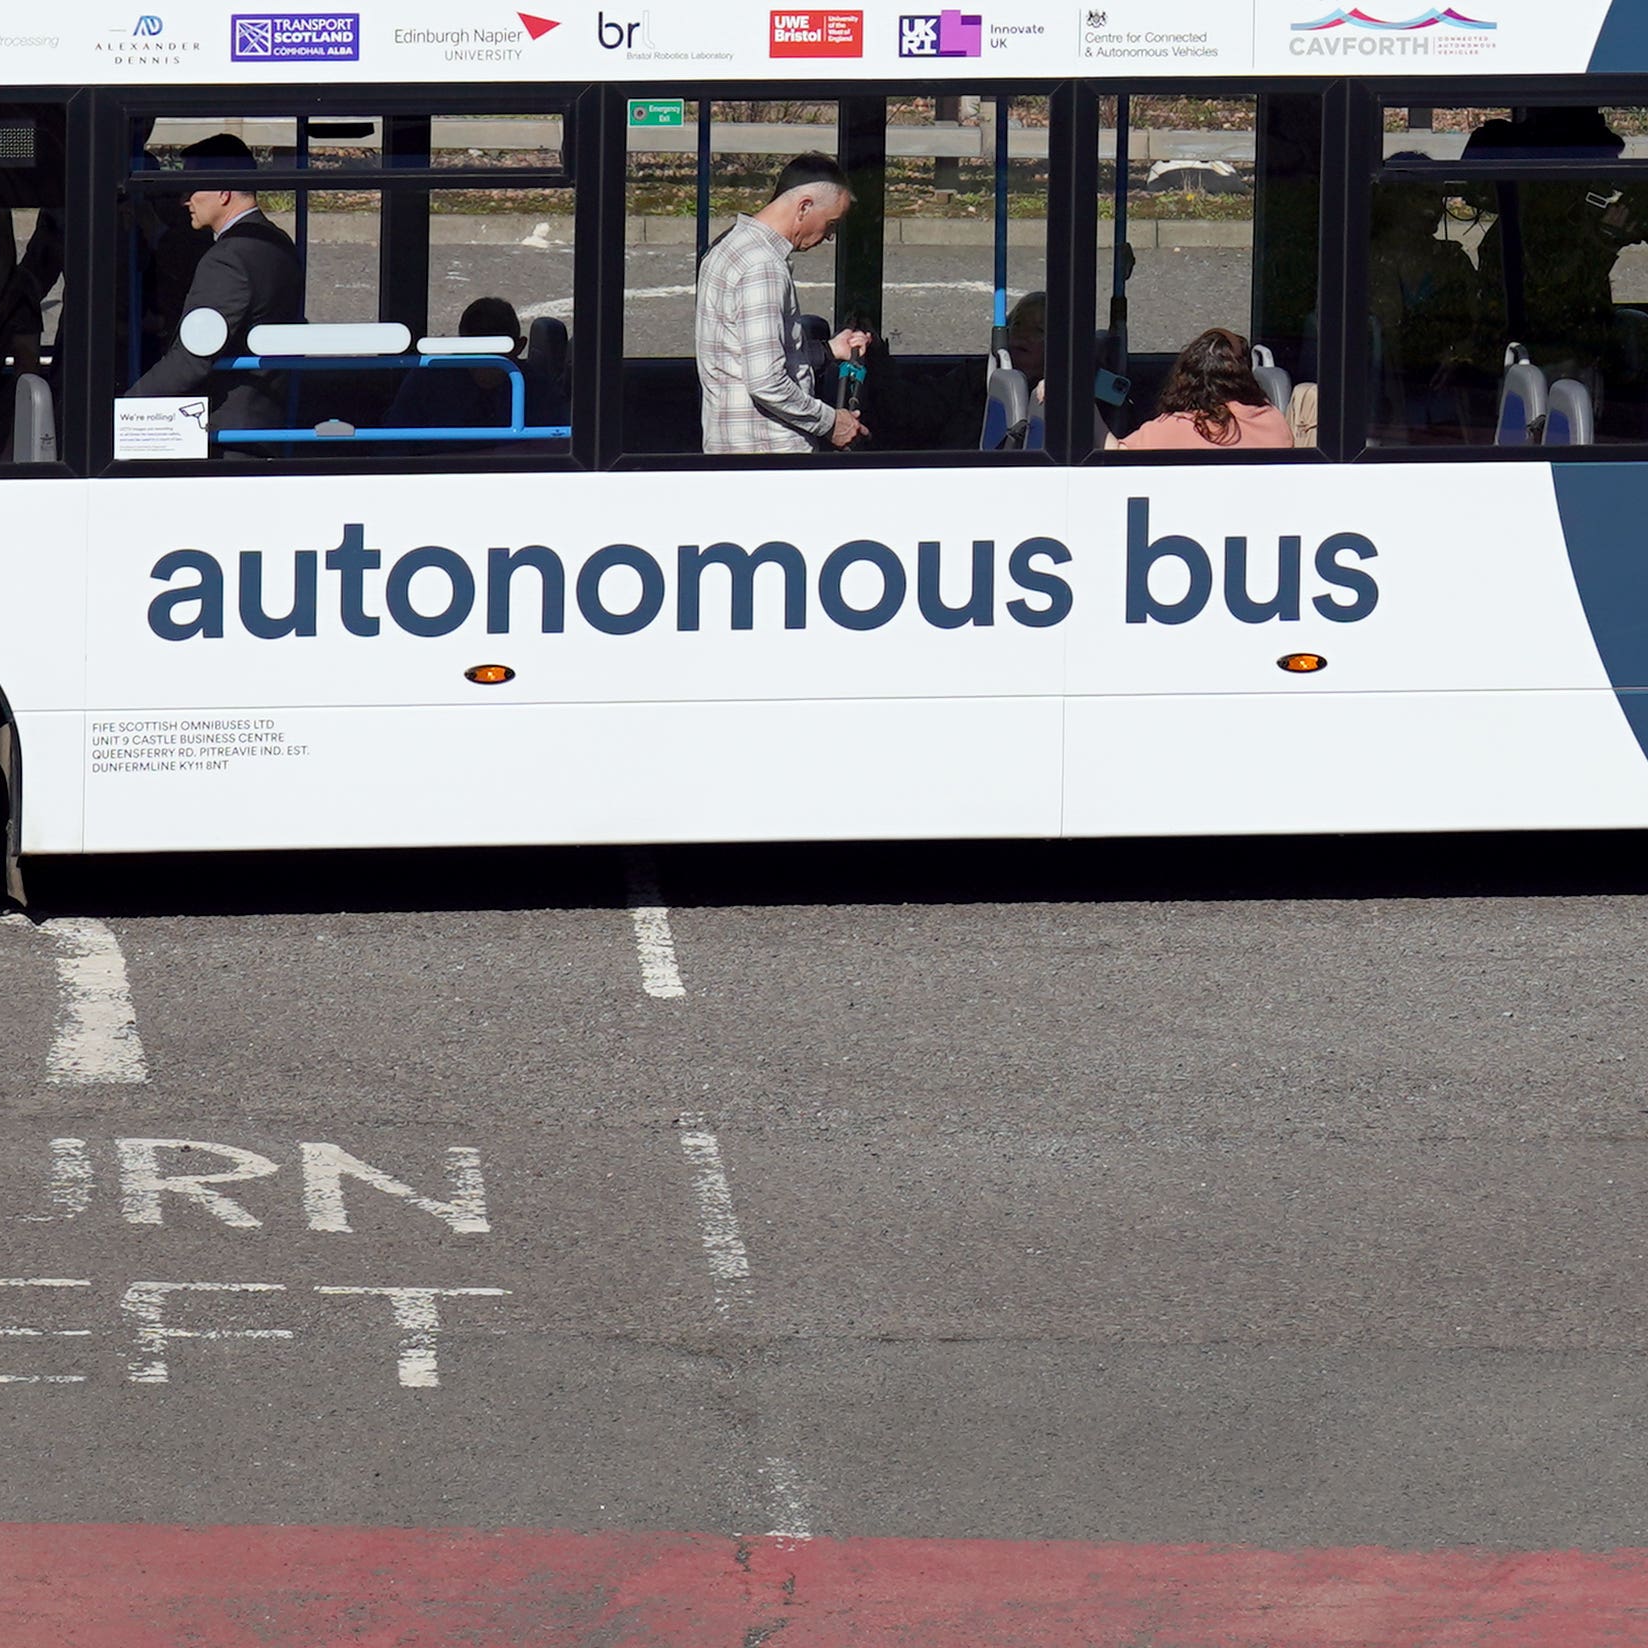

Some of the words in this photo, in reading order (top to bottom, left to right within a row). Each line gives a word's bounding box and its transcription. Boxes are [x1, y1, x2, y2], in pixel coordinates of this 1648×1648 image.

[274, 19, 353, 30] TRANSPORT
[774, 16, 809, 28] UWE
[990, 24, 1044, 34] Innovate
[274, 31, 353, 43] SCOTLAND
[395, 28, 468, 46] Edinburgh
[474, 28, 522, 45] Napier
[774, 29, 822, 42] Bristol
[1085, 33, 1122, 43] Centre
[1126, 32, 1141, 43] for
[1145, 32, 1207, 43] Connected
[95, 42, 200, 51] ALEXANDER
[990, 38, 1007, 48] UK
[1289, 37, 1429, 56] CAVFORTH
[327, 46, 353, 55] ALBA
[445, 50, 522, 61] UNIVERSITY
[626, 51, 651, 60] Bristol
[654, 51, 689, 60] Robotics
[691, 51, 733, 61] Laboratory
[1085, 46, 1093, 57] &
[1097, 46, 1168, 57] Autonomous
[1172, 45, 1218, 57] Vehicles
[115, 56, 180, 64] DENNIS
[120, 413, 145, 421] We're
[147, 413, 176, 422] rolling!
[147, 524, 1075, 641] autonomous
[1125, 497, 1380, 626] bus
[92, 723, 116, 733] FIFE
[118, 721, 178, 732] SCOTTISH
[180, 720, 251, 731] OMNIBUSES
[253, 719, 274, 730] LTD
[92, 735, 120, 746] UNIT
[123, 735, 129, 745] 9
[132, 734, 176, 745] CASTLE
[180, 733, 236, 744] BUSINESS
[238, 732, 284, 743] CENTRE
[92, 748, 175, 760] QUEENSFERRY
[178, 747, 197, 758] RD.
[200, 746, 257, 757] PITREAVIE
[260, 745, 284, 756] IND.
[287, 745, 310, 755] EST.
[92, 761, 176, 773] DUNFERMLINE
[179, 760, 203, 770] KY11
[206, 760, 229, 770] 8NT
